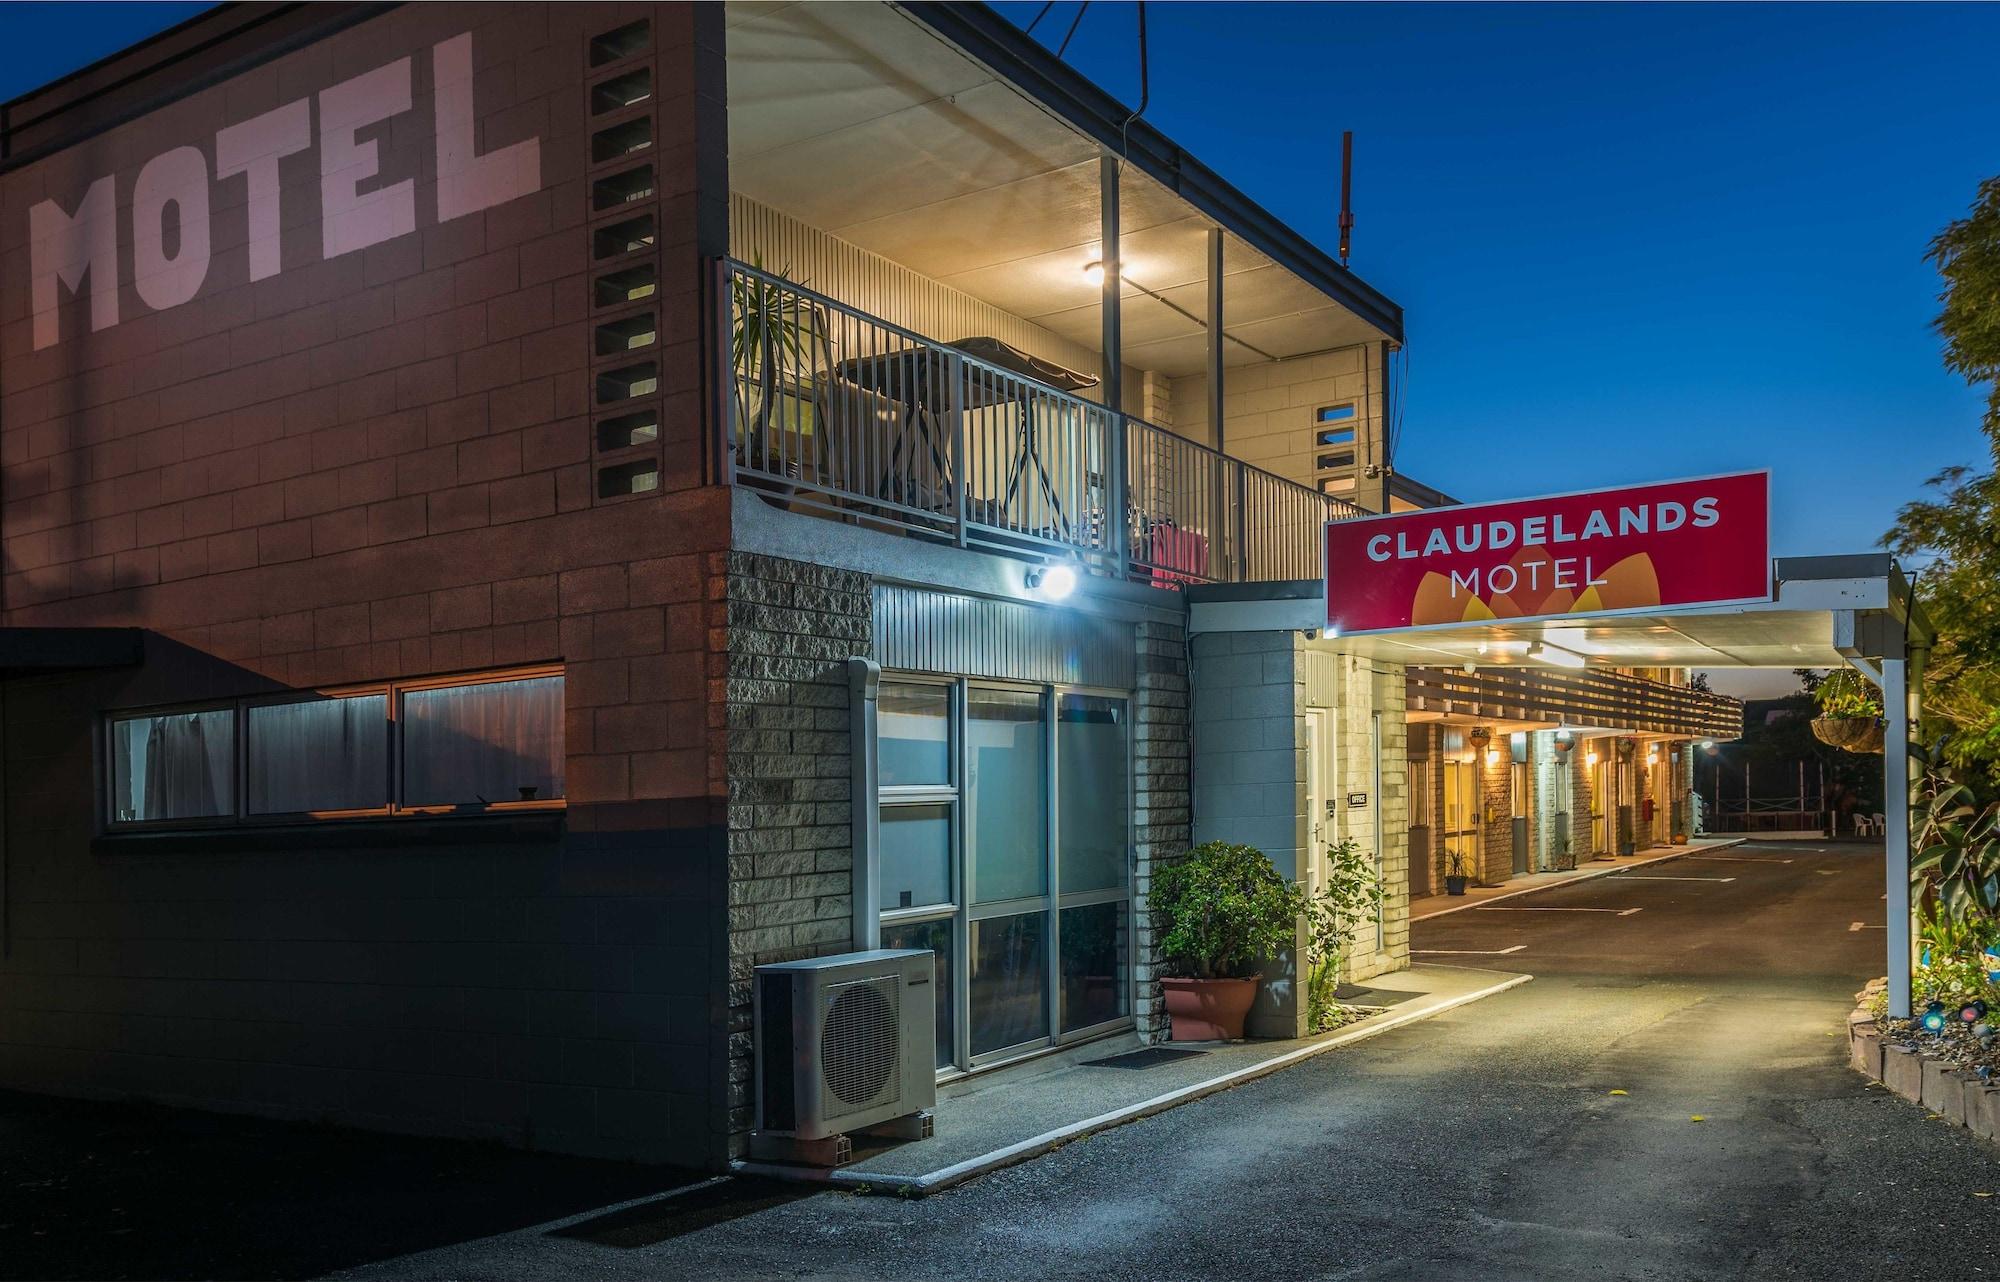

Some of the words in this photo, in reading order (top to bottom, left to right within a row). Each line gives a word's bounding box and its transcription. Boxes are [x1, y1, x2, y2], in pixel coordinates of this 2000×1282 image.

[29, 31, 541, 352] MOTEL
[1366, 497, 1720, 562] CLAUDELANDS
[1450, 556, 1608, 598] MOTEL
[1351, 794, 1366, 804] OFFICE
